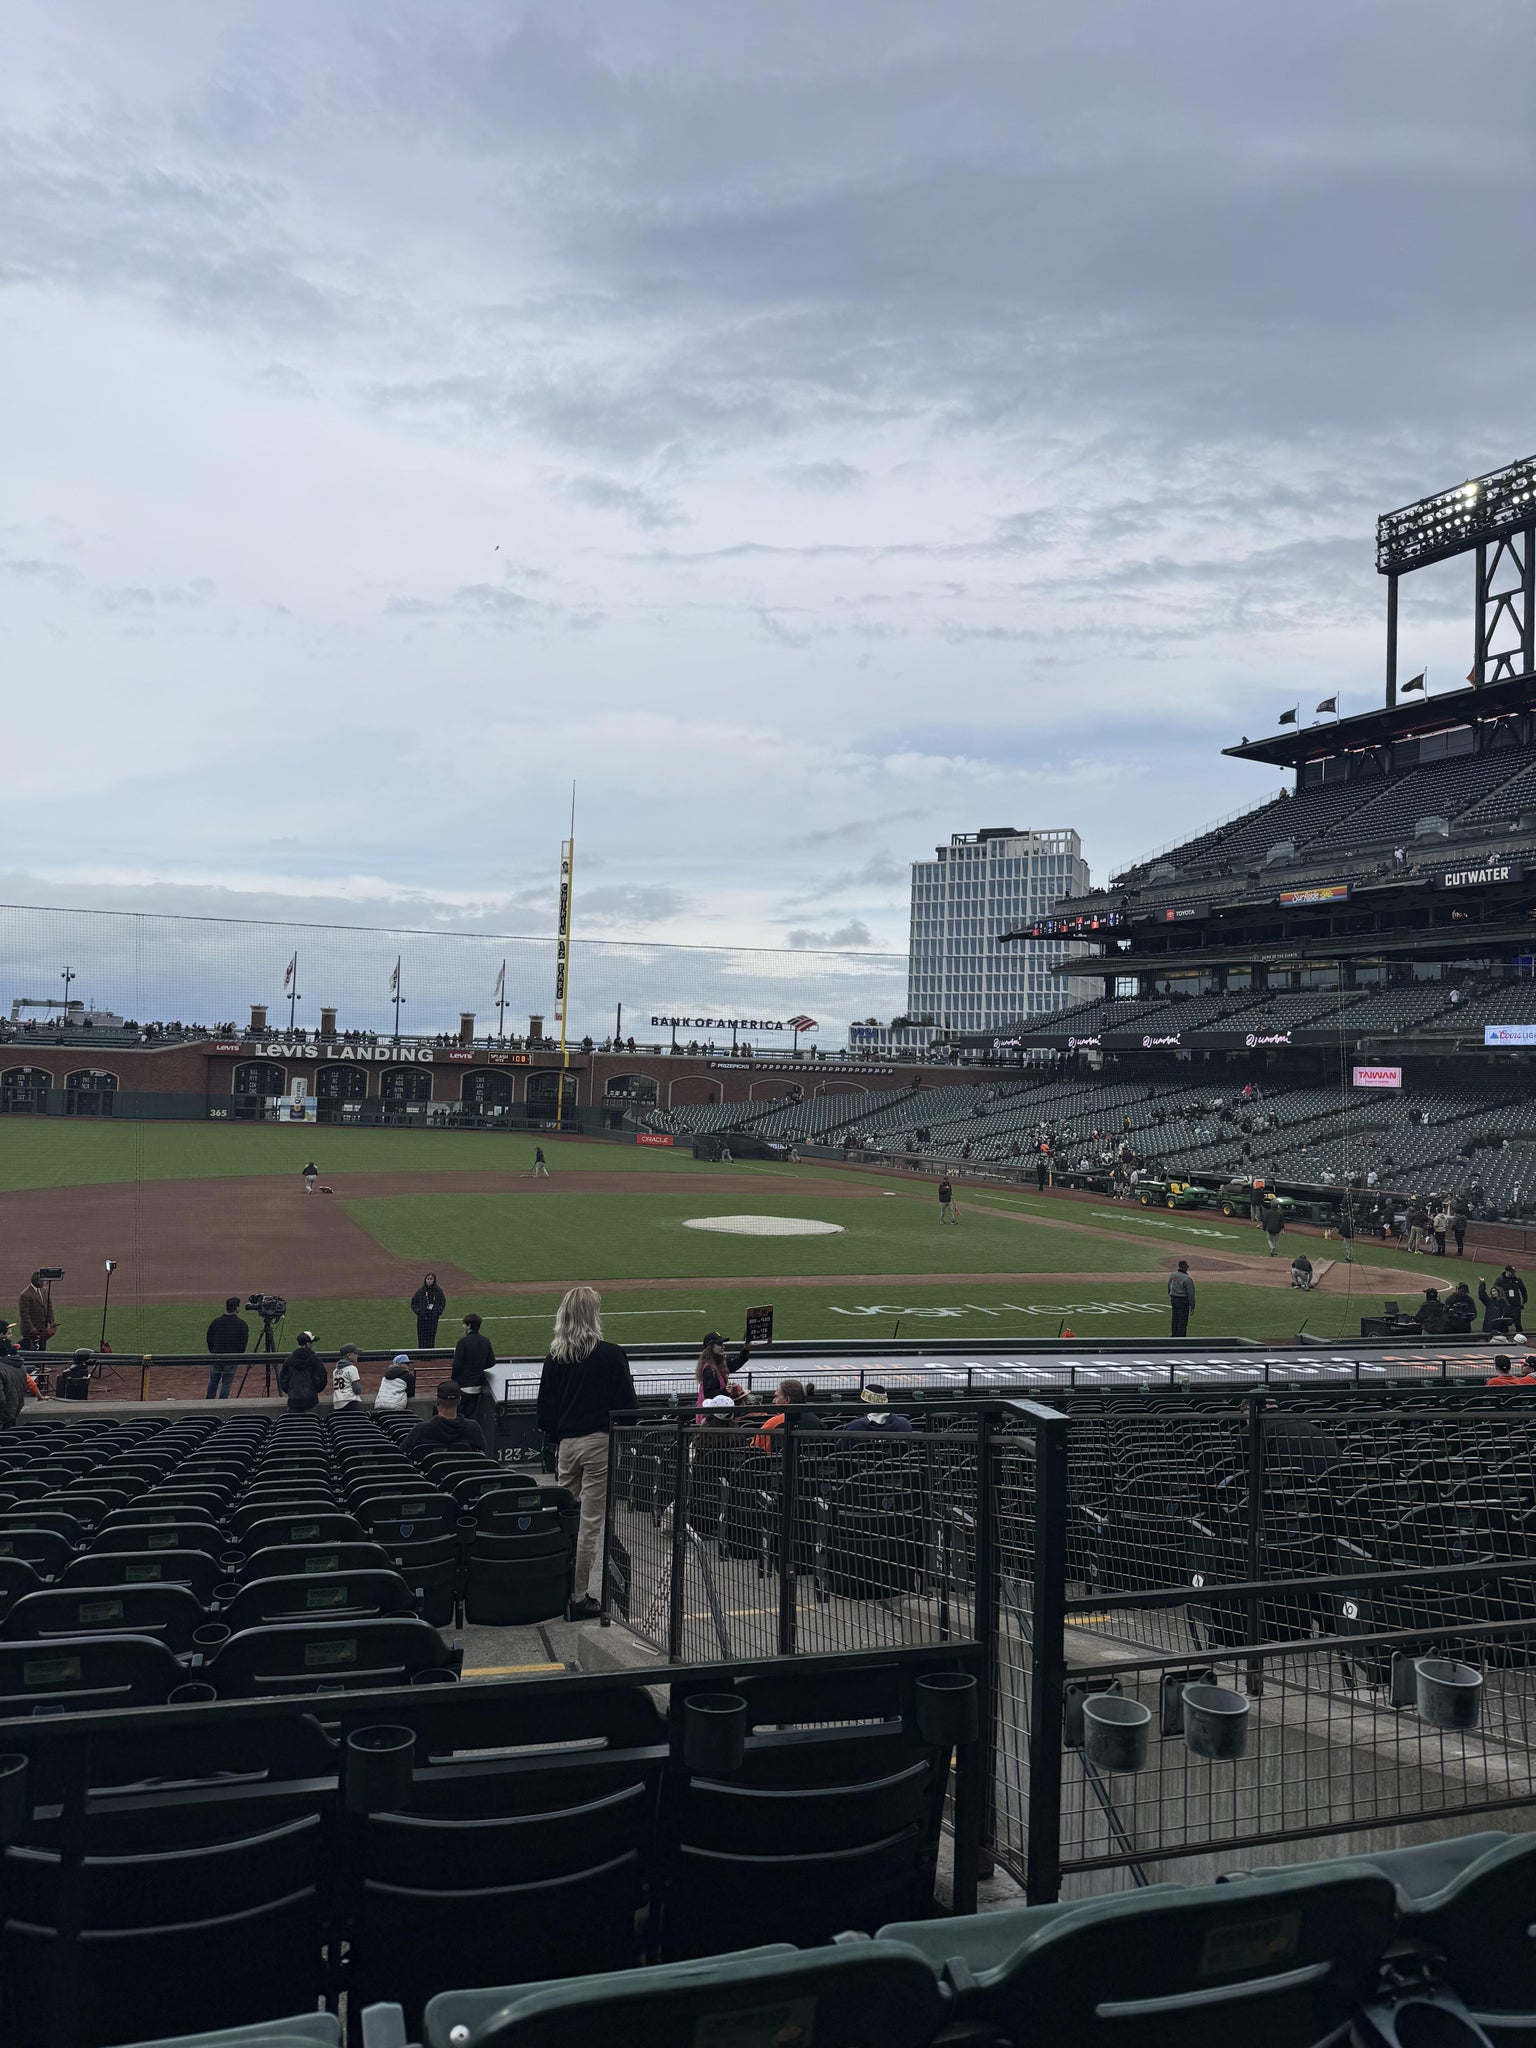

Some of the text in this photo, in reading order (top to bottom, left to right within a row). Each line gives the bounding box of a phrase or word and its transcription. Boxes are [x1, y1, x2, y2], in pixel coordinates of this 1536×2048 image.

[1445, 867, 1509, 887] CUTWATER
[556, 963, 565, 999] FARE
[651, 1016, 784, 1030] BANK OF AMERICA
[850, 1028, 878, 1040] VISA
[1500, 1030, 1522, 1039] Coors
[326, 1046, 434, 1062] LANDING
[964, 1301, 1172, 1316] Health
[924, 1362, 1055, 1380] SAN
[1057, 1357, 1387, 1378] FRANCISCO
[334, 1377, 345, 1390] 28
[496, 1447, 522, 1462] 123
